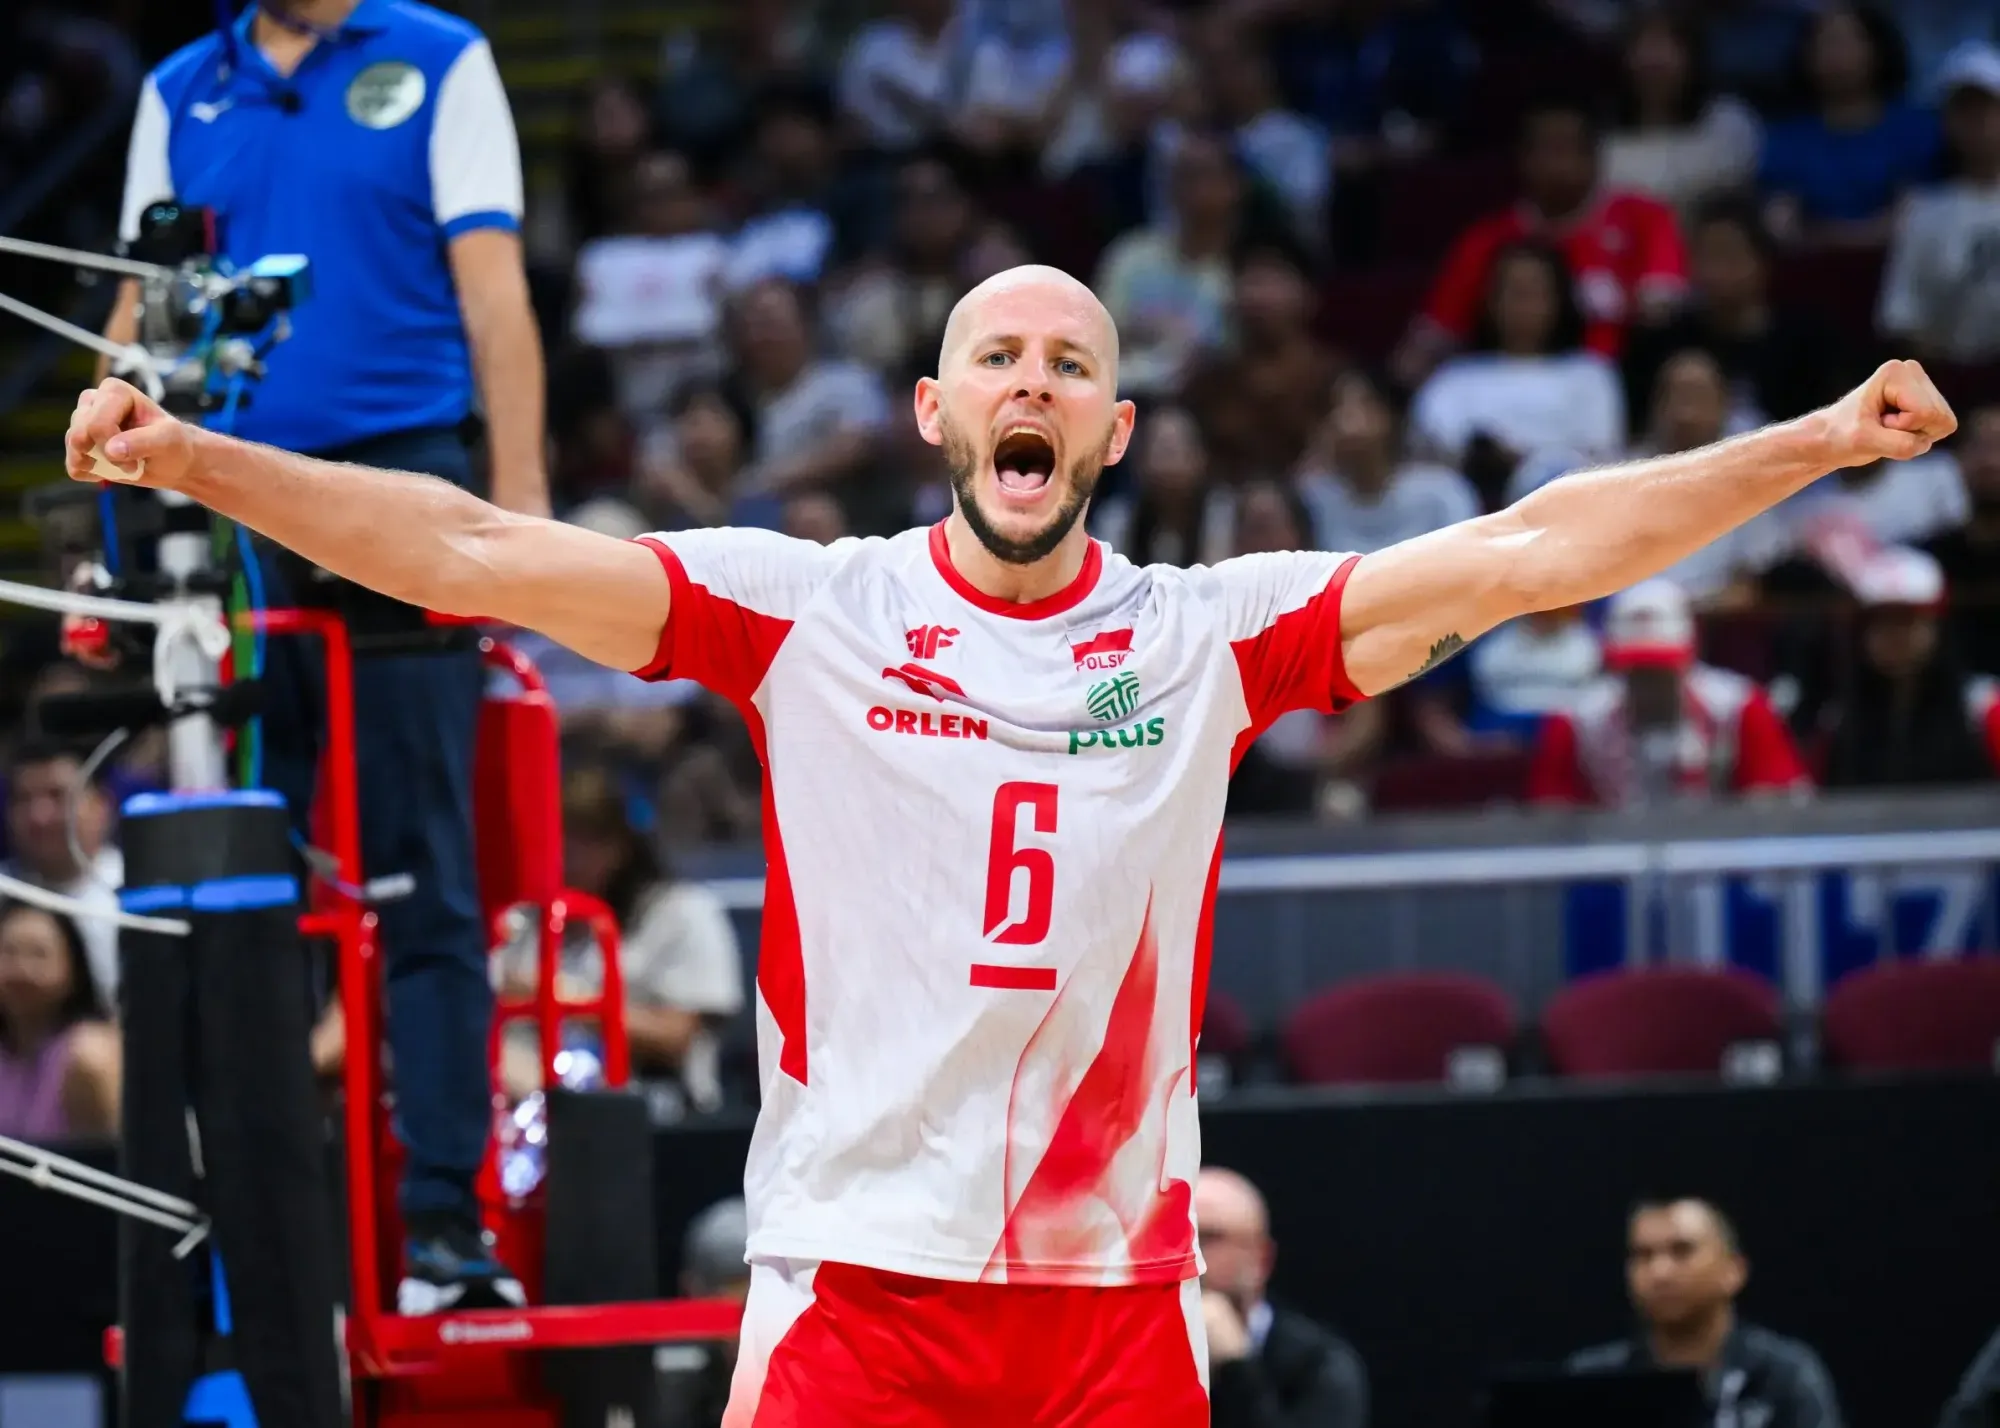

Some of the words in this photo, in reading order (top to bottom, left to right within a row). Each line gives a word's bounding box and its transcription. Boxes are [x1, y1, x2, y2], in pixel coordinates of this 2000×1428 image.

[866, 705, 989, 740] ORLEN
[1068, 717, 1165, 755] plus
[983, 781, 1059, 945] 6
